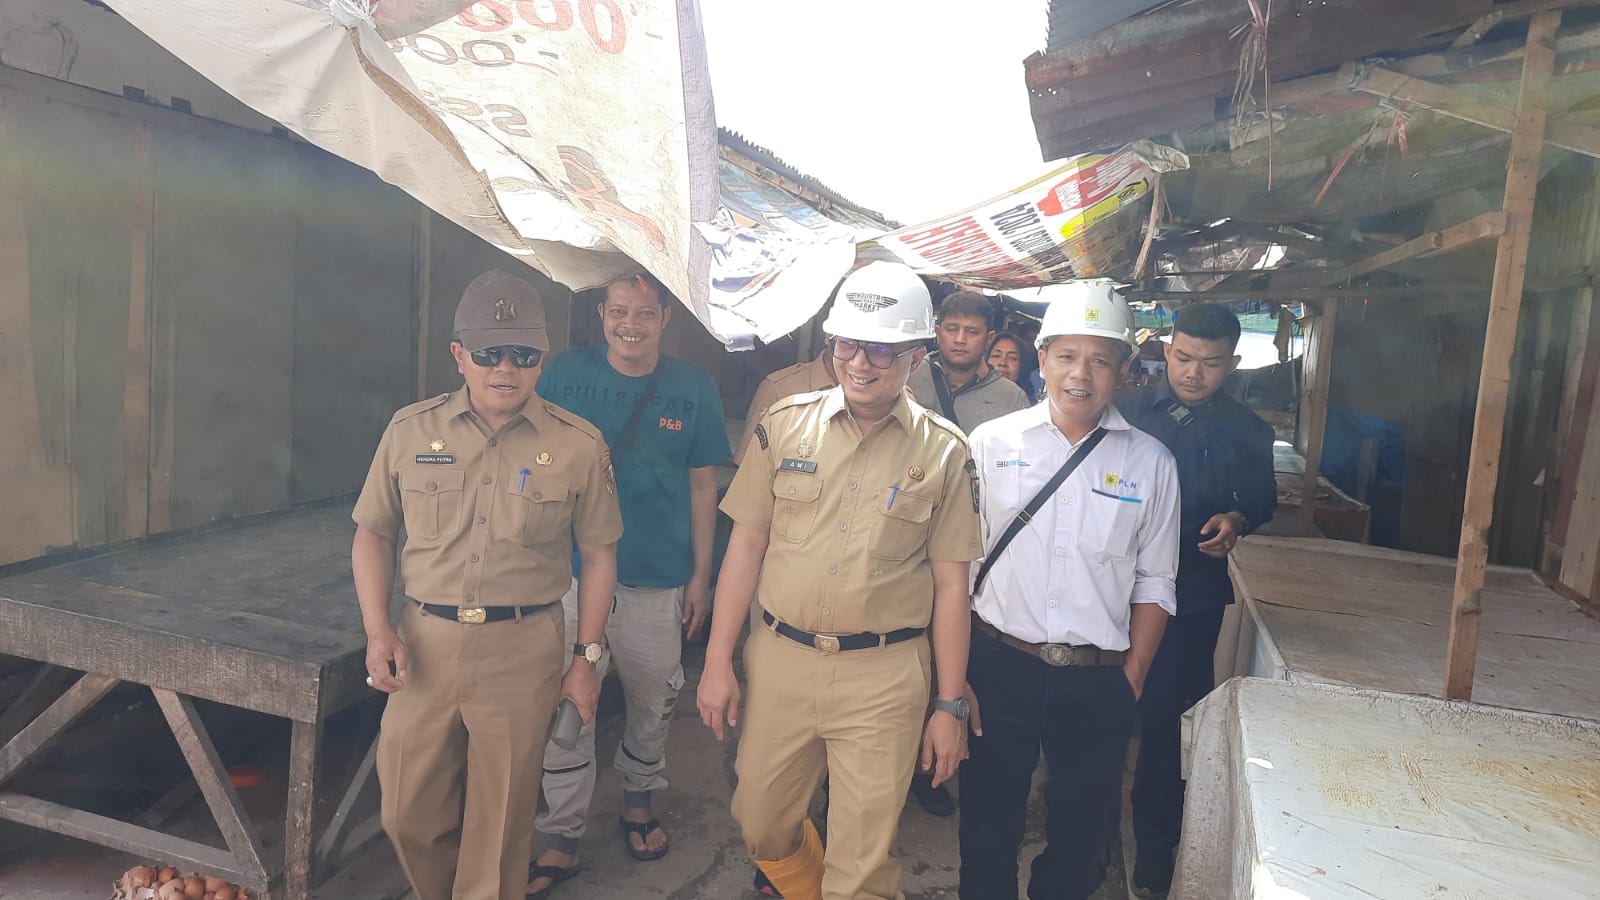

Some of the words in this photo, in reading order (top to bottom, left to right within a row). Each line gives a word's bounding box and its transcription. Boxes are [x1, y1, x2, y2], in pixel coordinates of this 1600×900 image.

[990, 201, 1041, 236] 2024
[854, 302, 880, 311] MARKET
[659, 417, 682, 431] P&B
[1118, 479, 1137, 489] PLN
